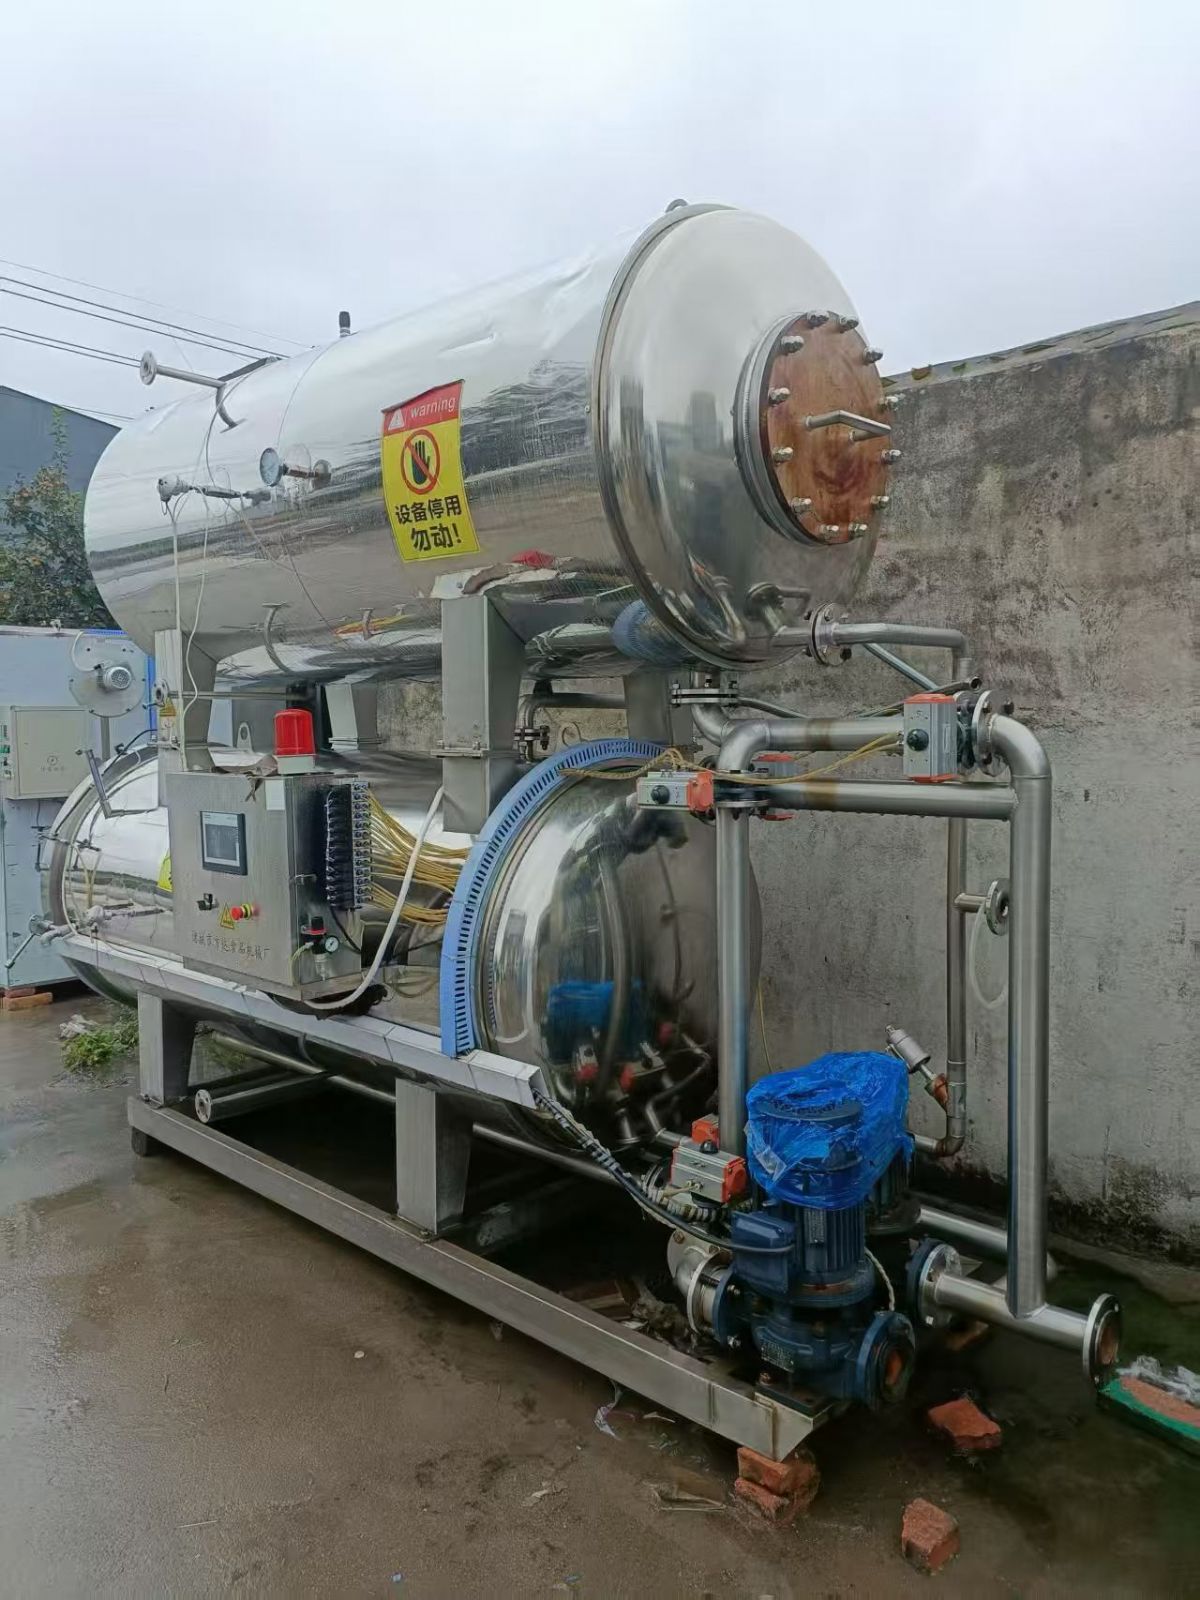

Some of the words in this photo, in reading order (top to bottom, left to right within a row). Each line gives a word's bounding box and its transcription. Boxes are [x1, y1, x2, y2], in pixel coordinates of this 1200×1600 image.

[410, 397, 456, 419] warning
[395, 495, 462, 525] 设备停用
[411, 523, 462, 552] 勿动!
